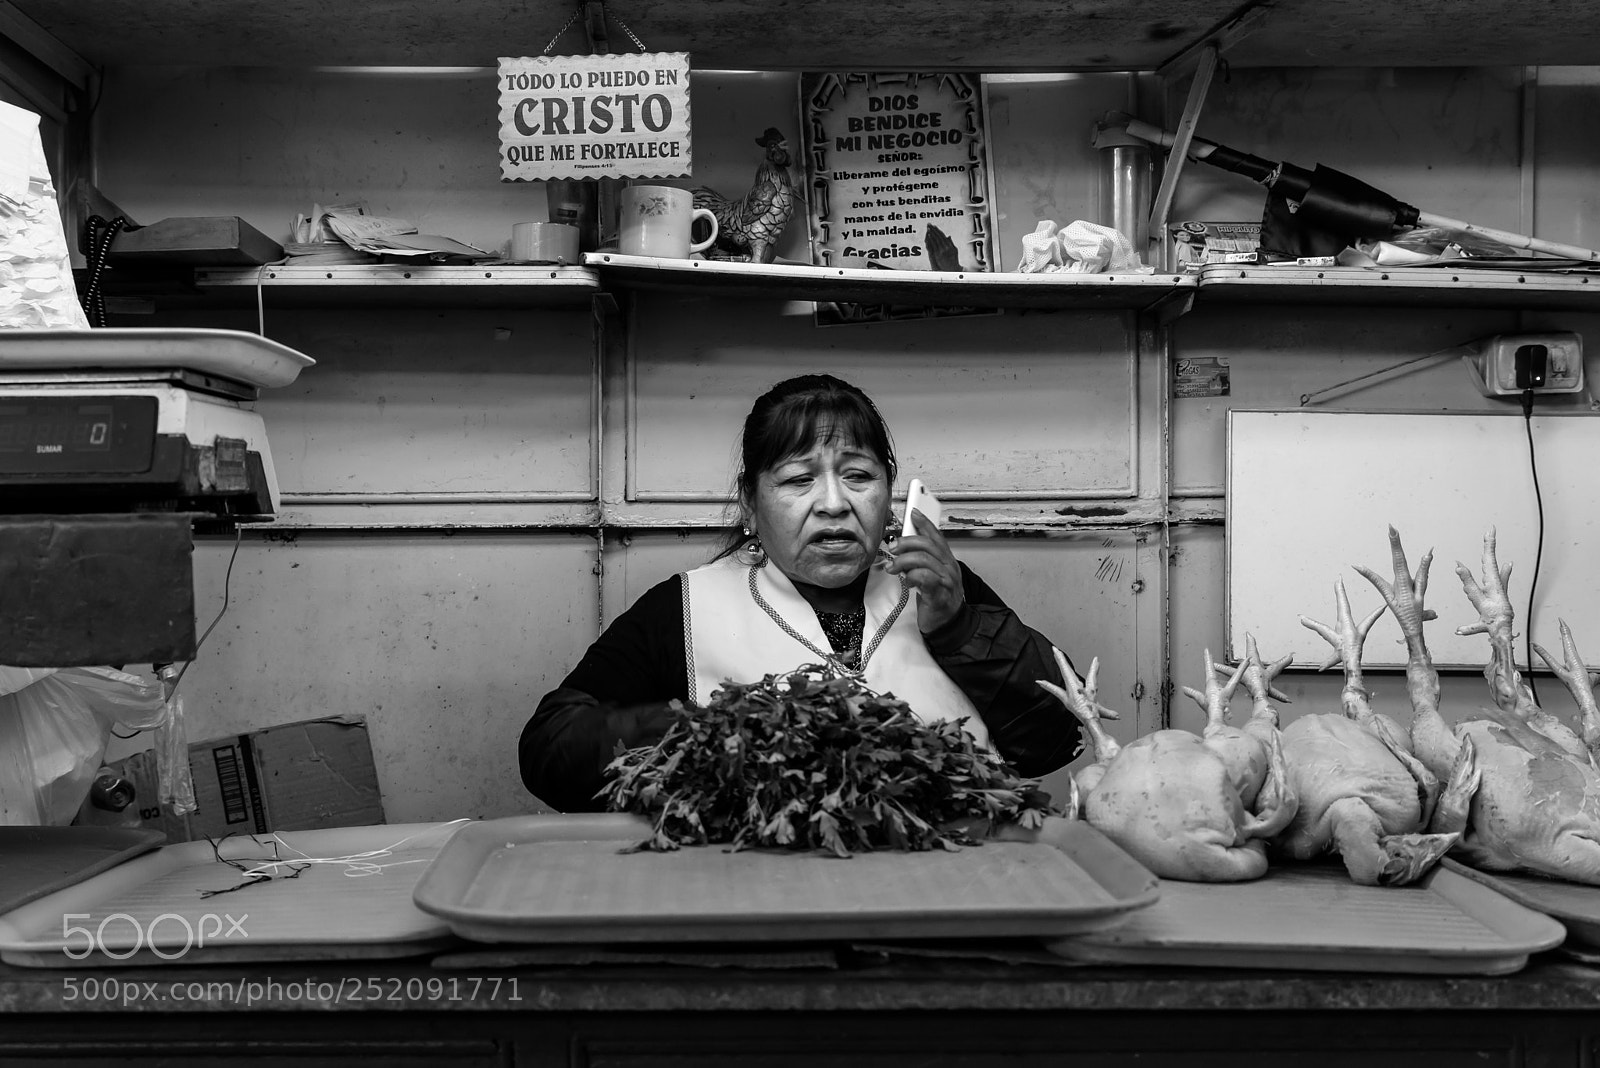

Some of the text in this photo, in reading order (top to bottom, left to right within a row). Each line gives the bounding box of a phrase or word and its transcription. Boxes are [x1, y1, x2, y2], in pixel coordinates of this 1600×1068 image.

[560, 73, 582, 89] LO
[587, 70, 650, 88] PUEDO
[655, 69, 678, 86] EN
[868, 94, 919, 112] DIOS
[514, 93, 672, 136] CRISTO
[848, 112, 942, 133] BENDICE
[835, 129, 963, 152] MI NEGOCIO
[507, 141, 680, 166] QUE ME FORTALECE
[877, 150, 923, 163] SEÑOR:
[833, 164, 966, 181] Liberame del egoísmo
[861, 181, 939, 194] y protégeme
[851, 195, 952, 209] con tus benditas
[844, 208, 964, 224] manos de la envidia
[841, 225, 917, 240] y la maldad.
[842, 243, 922, 260] Gracias
[90, 423, 107, 444] 0
[36, 445, 63, 454] SUMAR
